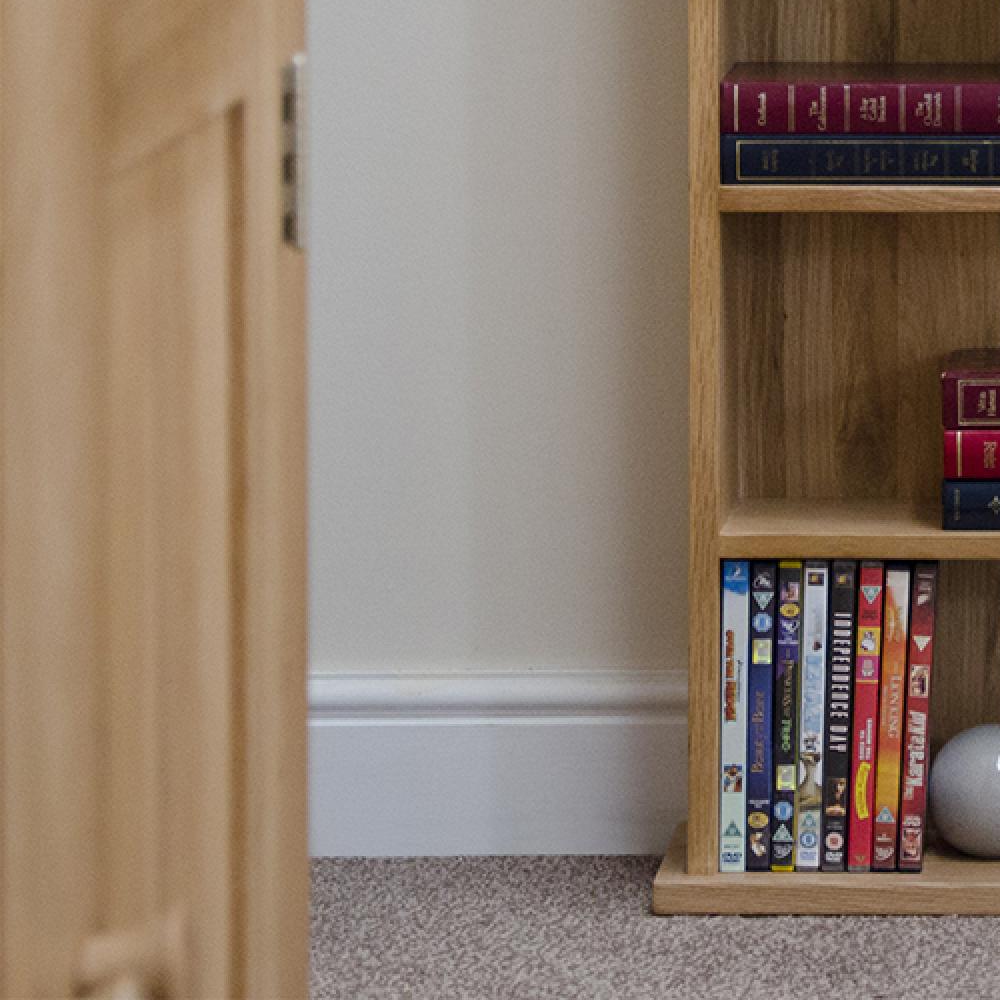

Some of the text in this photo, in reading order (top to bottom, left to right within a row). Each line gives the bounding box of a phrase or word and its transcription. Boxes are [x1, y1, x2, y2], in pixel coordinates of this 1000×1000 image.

[829, 612, 853, 753] INDEPENDENCE DAY
[889, 674, 902, 705] LION
[887, 706, 900, 739] KING
[907, 710, 926, 735] Kid
[905, 735, 925, 787] Karate
